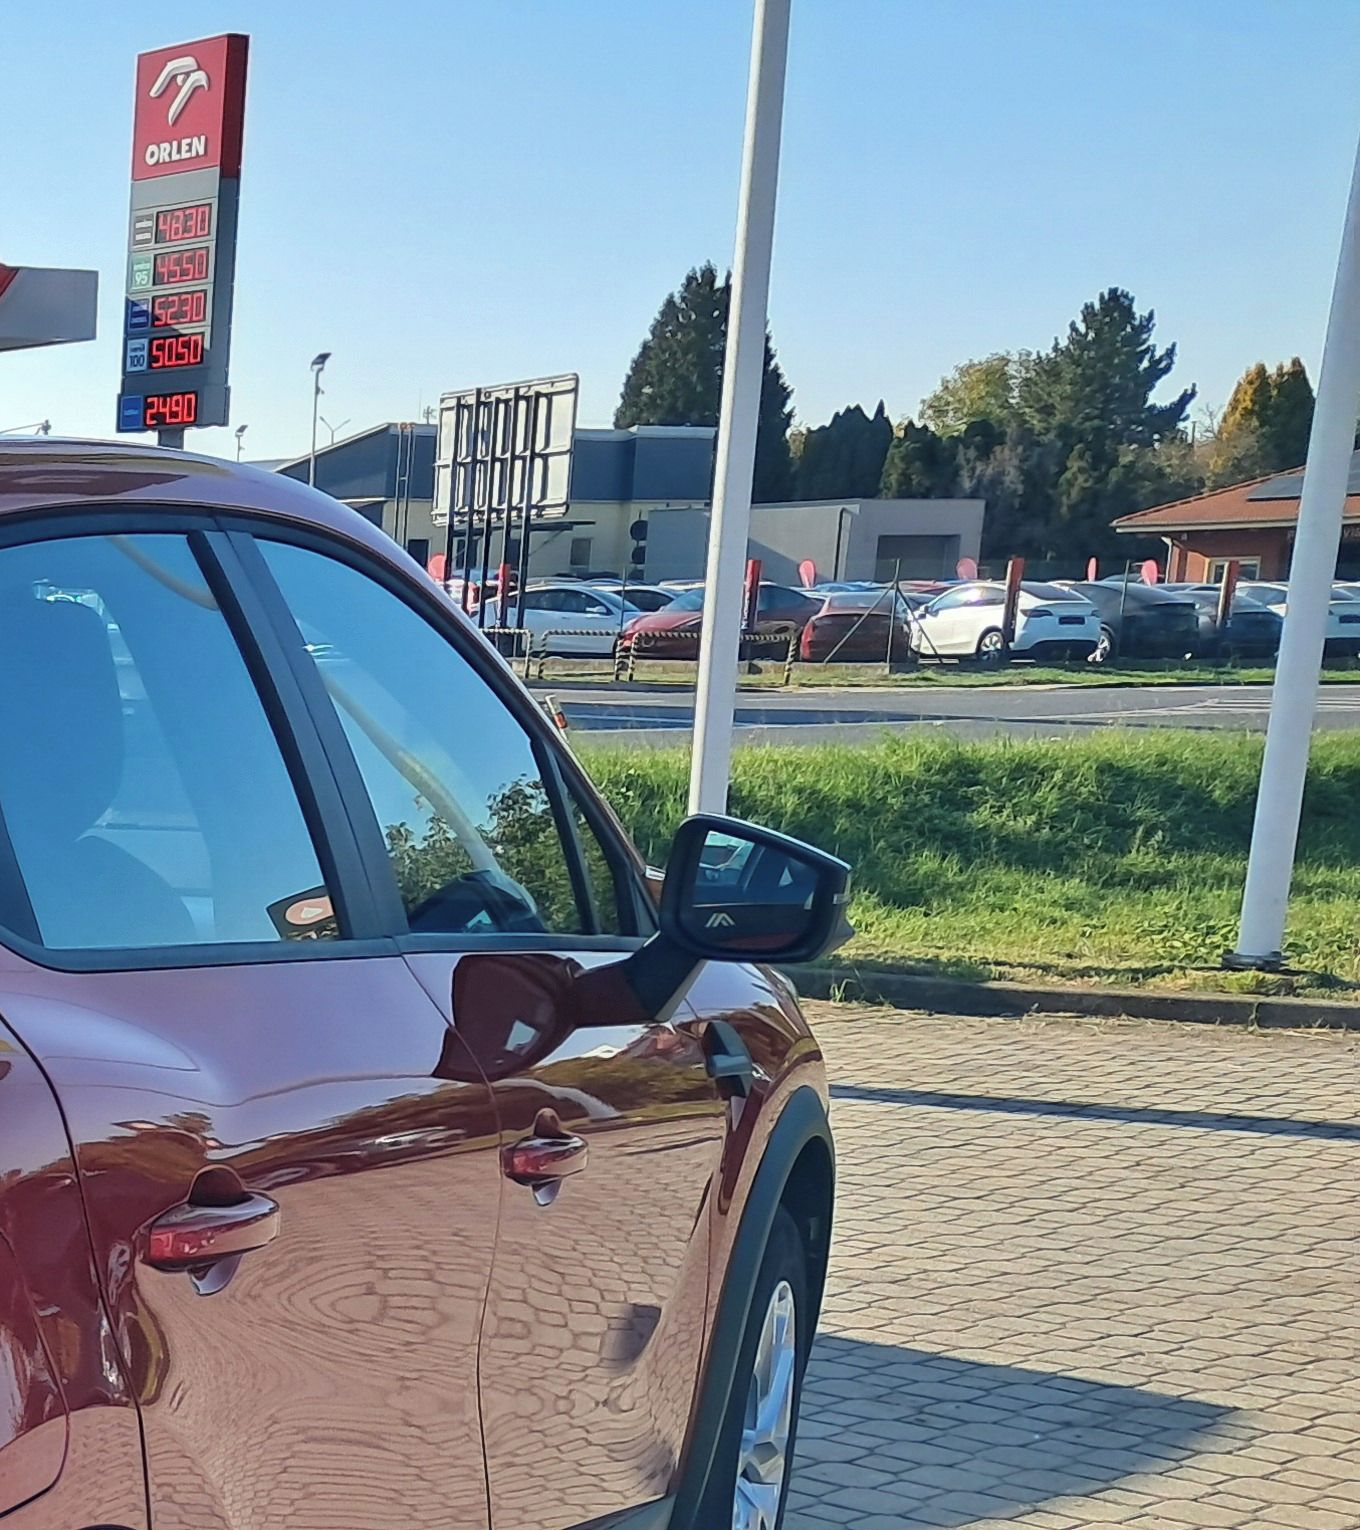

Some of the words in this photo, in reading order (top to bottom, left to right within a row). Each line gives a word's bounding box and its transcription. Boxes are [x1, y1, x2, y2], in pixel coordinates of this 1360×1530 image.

[145, 135, 206, 166] ORLEN
[135, 271, 149, 285] 95
[130, 355, 145, 368] 100
